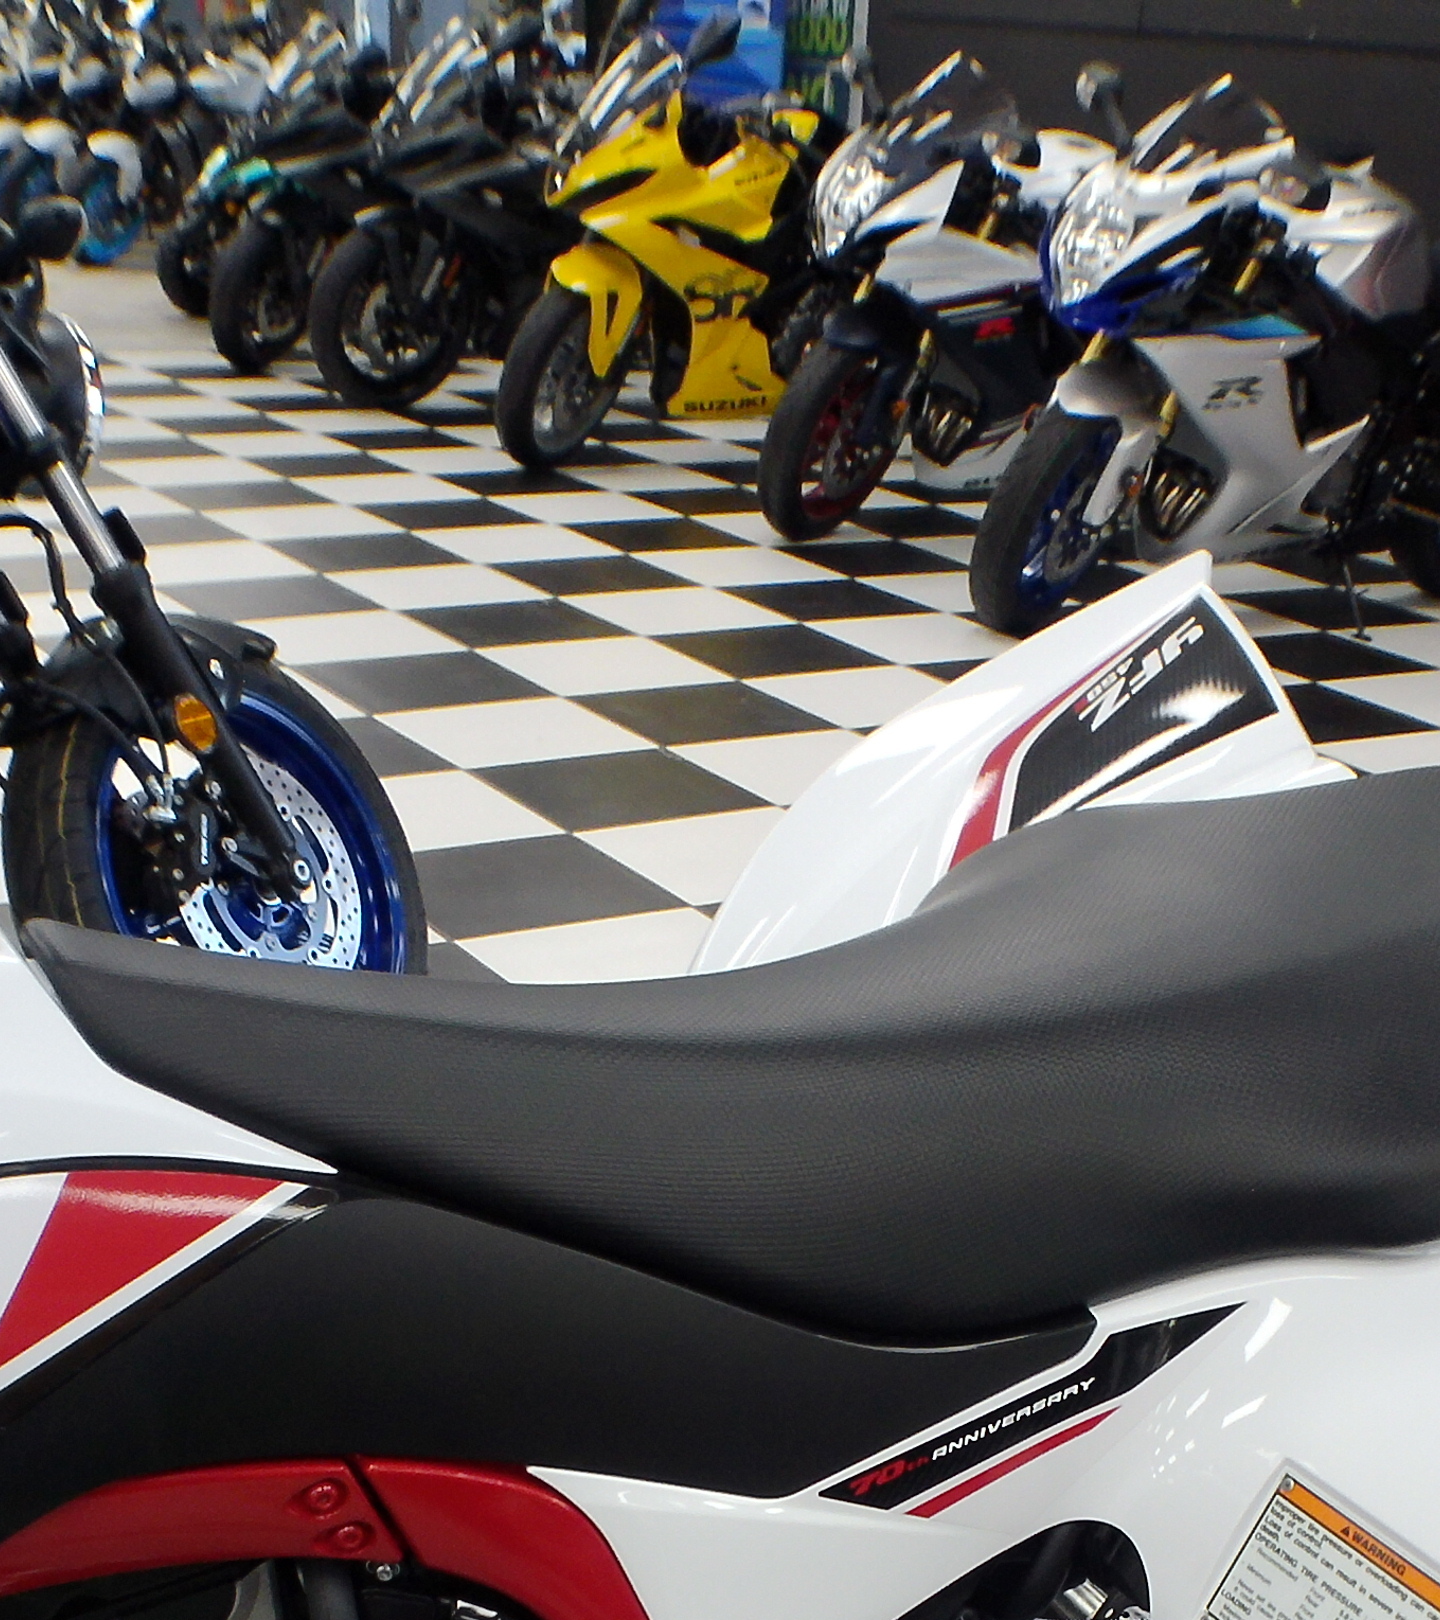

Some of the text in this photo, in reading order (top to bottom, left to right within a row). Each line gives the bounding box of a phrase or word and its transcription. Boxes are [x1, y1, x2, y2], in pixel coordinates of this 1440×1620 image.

[683, 395, 767, 413] SUZUKI
[932, 1376, 1097, 1462] ANNIVERSARY
[1253, 1529, 1299, 1569] OPERATING
[1299, 1564, 1319, 1584] TIRE
[1319, 1579, 1364, 1617] PRESSURE
[1263, 1514, 1283, 1533] Loss
[1319, 1556, 1336, 1572] can
[1334, 1567, 1358, 1589] result
[1367, 1591, 1394, 1616] severe
[1273, 1497, 1307, 1527] Improper
[1319, 1532, 1354, 1562] pressure
[1363, 1564, 1409, 1603] overloading
[1350, 1529, 1408, 1577] WARNING
[1219, 1587, 1253, 1617] LOADING
